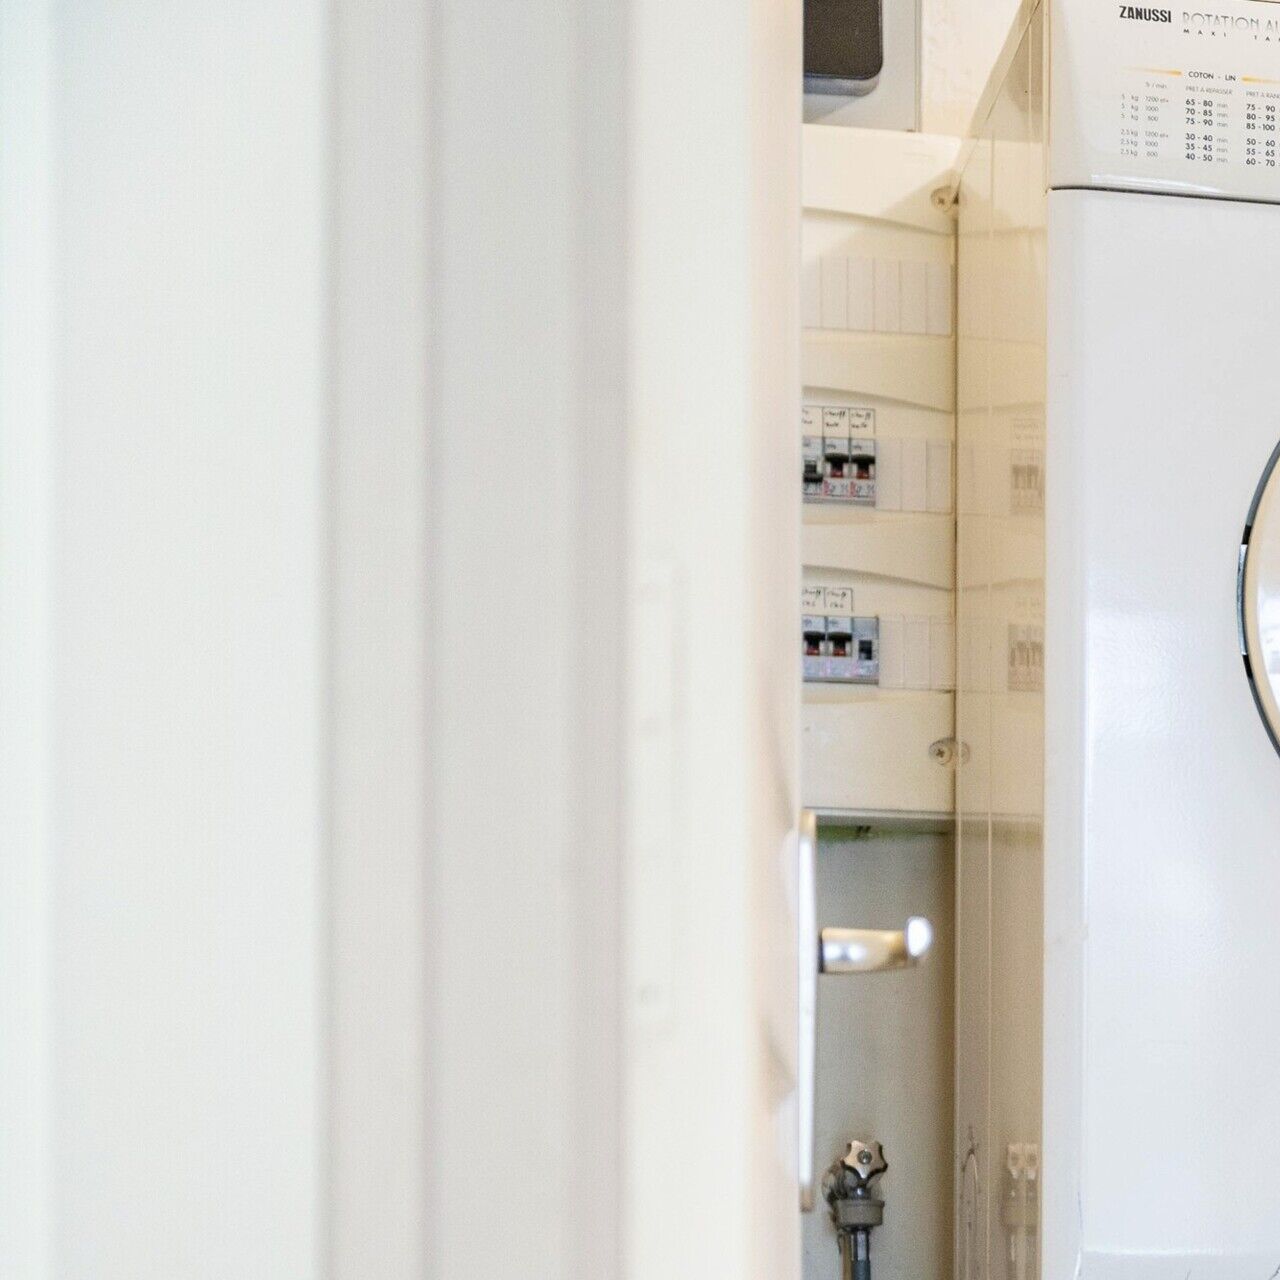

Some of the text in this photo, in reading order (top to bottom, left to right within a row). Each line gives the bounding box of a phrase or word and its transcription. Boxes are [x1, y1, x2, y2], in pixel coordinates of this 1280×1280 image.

[1119, 5, 1171, 23] ZANUSSI
[1183, 12, 1259, 30] ROTATION
[1183, 29, 1227, 37] MAXI
[1188, 71, 1236, 82] COTON LIN
[1185, 98, 1195, 106] 65
[1203, 109, 1213, 117] 85
[1185, 117, 1195, 125] 75
[1203, 118, 1213, 126] 90
[1203, 134, 1213, 142] 40
[1185, 142, 1195, 150] 35
[1203, 144, 1213, 152] 45
[1203, 154, 1213, 162] 50
